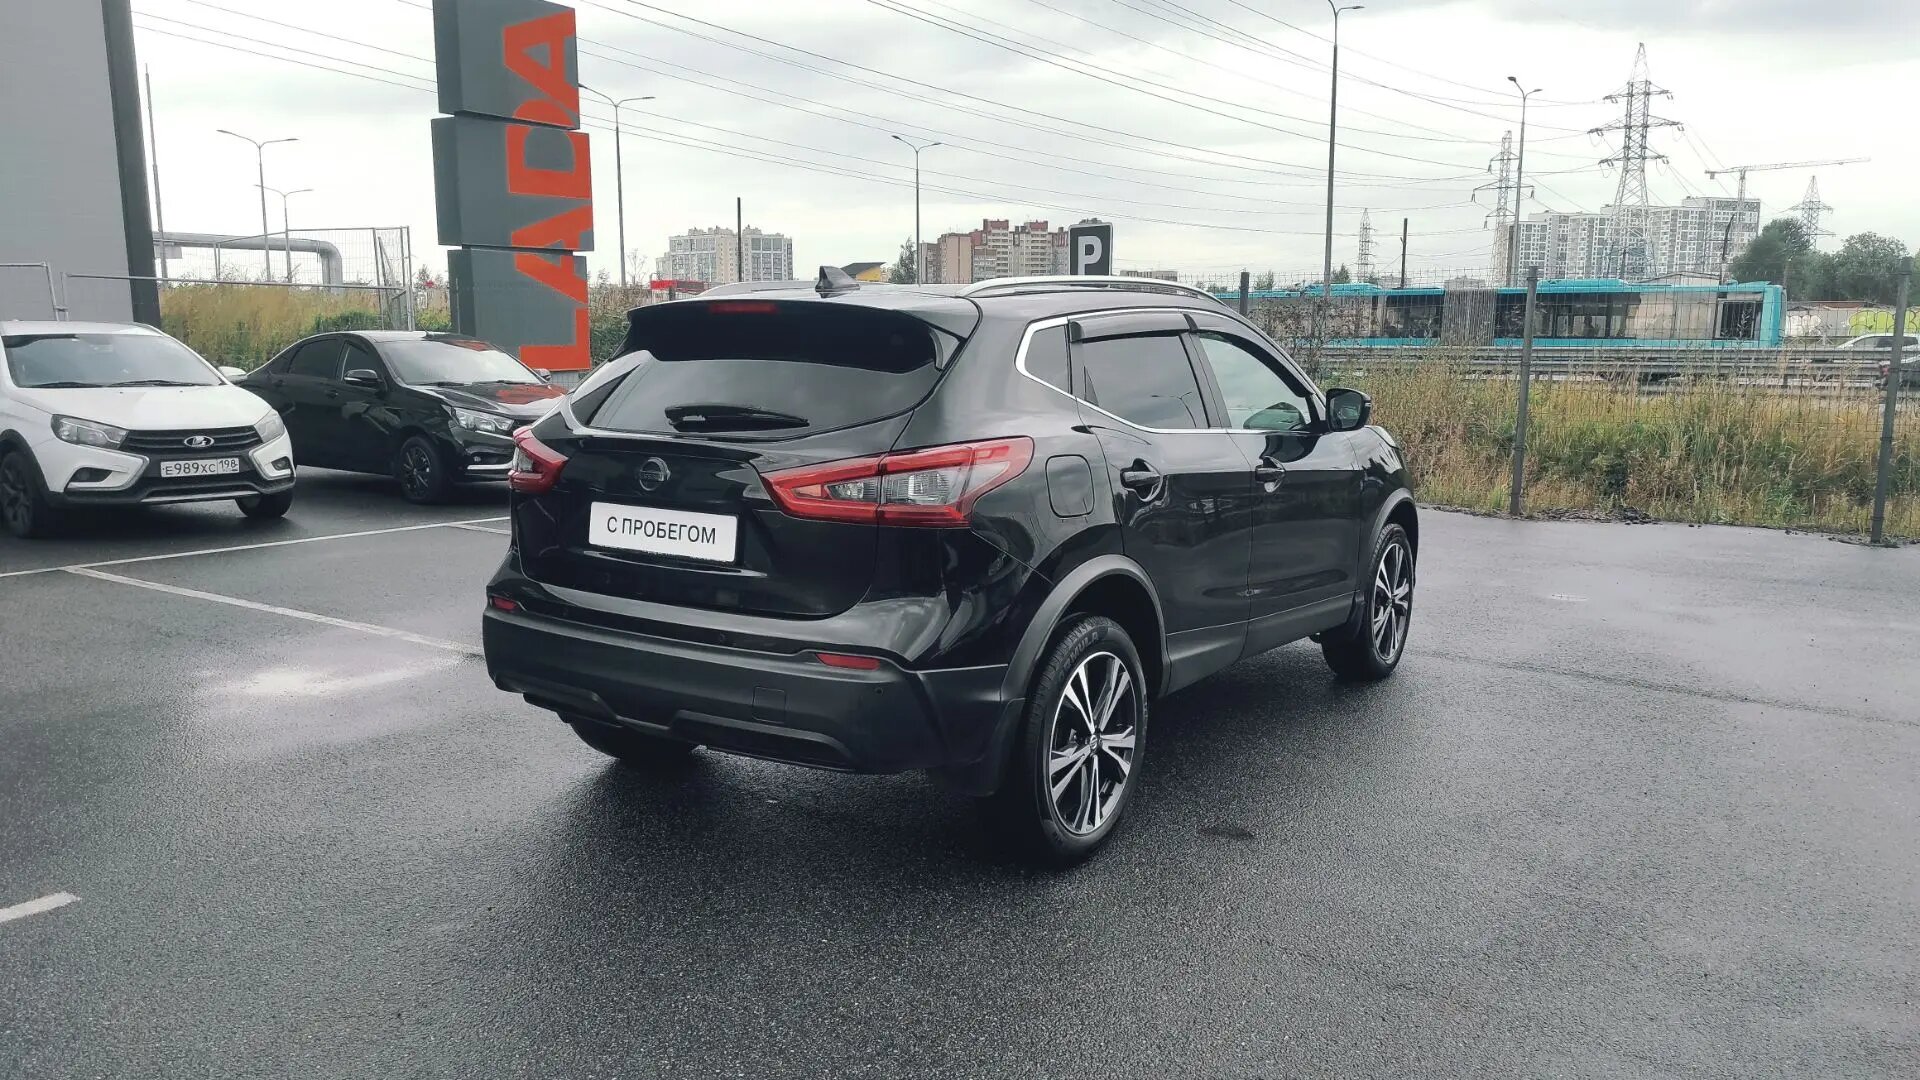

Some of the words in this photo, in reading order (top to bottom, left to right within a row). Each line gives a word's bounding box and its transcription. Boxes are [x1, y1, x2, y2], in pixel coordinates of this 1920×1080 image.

[503, 8, 594, 372] LADA
[1077, 235, 1103, 276] P
[606, 516, 618, 533] С
[621, 518, 717, 545] ПРОБЕГОМ
